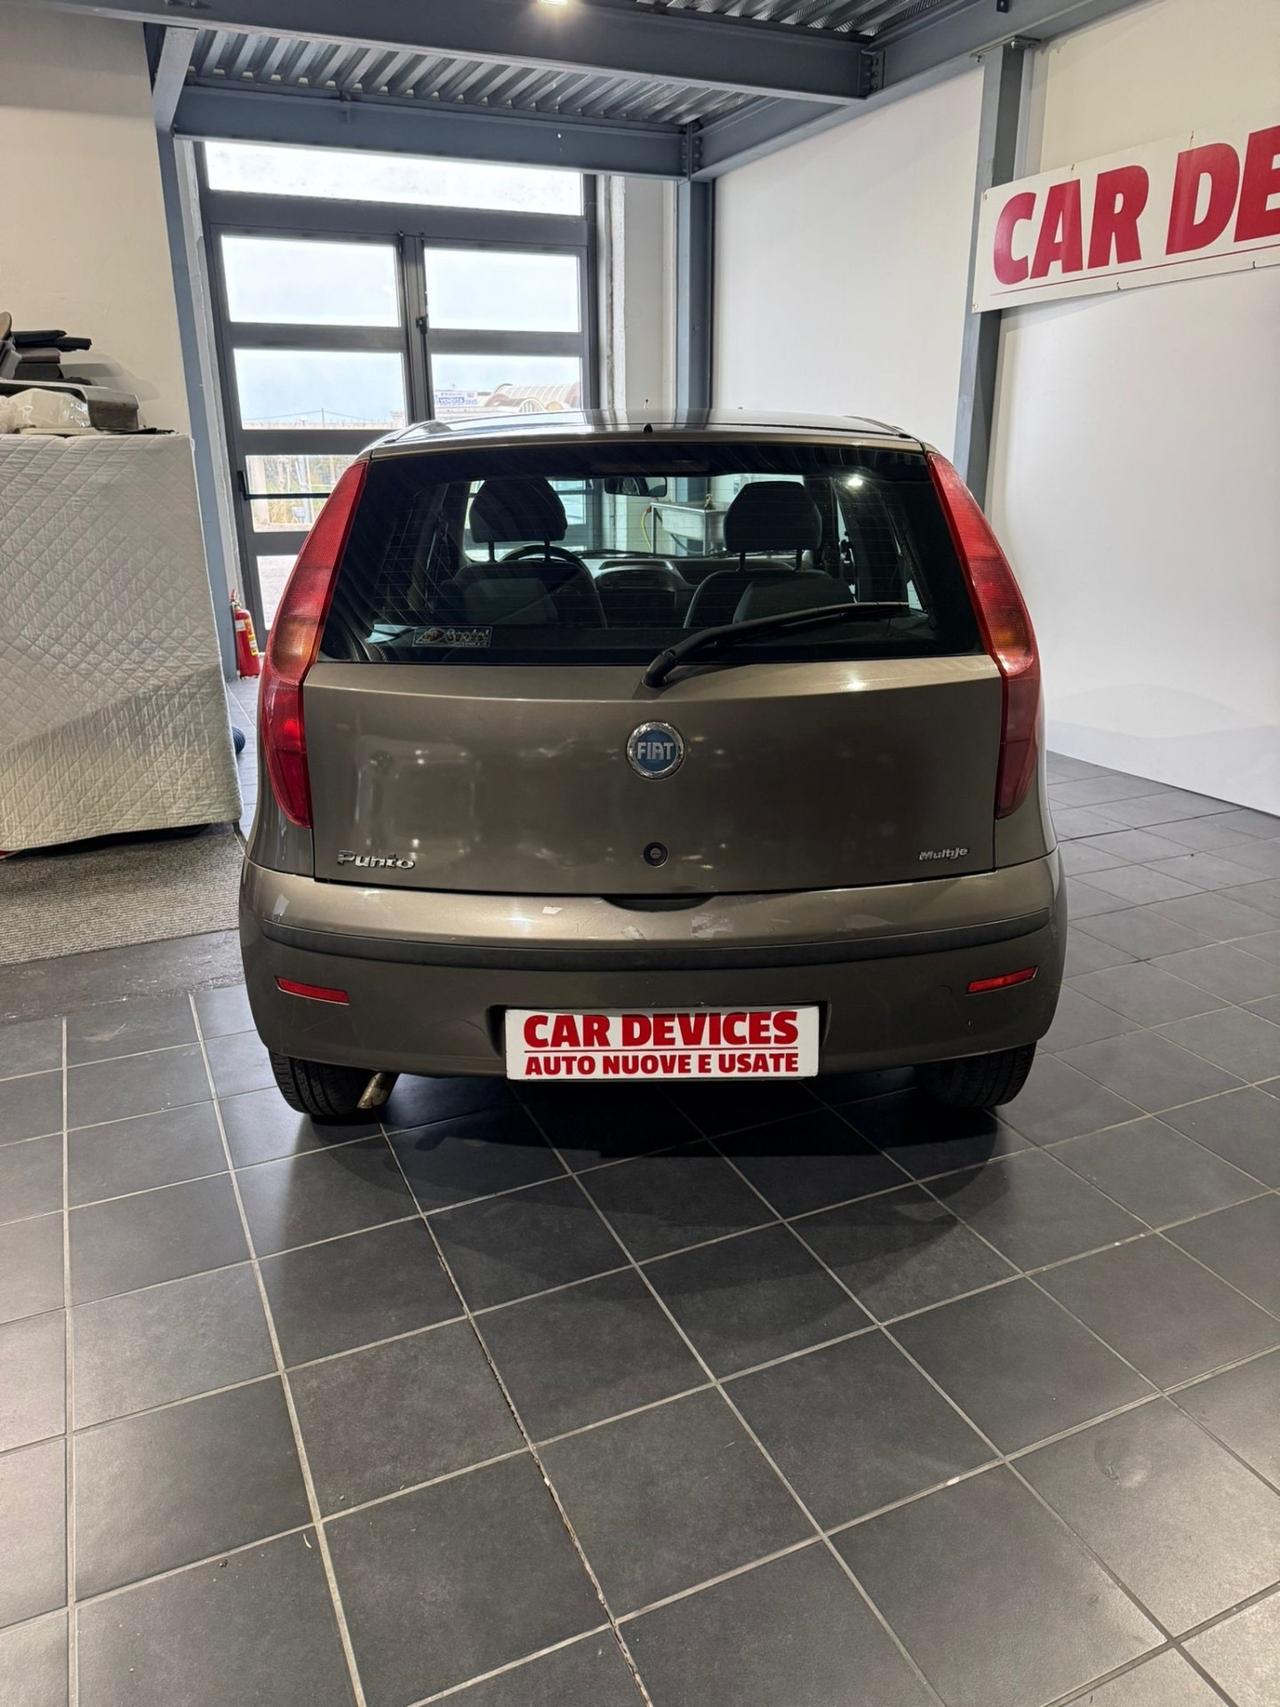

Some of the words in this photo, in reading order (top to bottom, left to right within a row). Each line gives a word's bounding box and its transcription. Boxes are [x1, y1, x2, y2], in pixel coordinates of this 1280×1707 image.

[993, 165, 1149, 285] CAR
[637, 742, 674, 760] FIAT
[337, 849, 415, 869] Punto
[523, 1014, 610, 1048] CAR
[622, 1011, 799, 1048] DEVICES
[525, 1054, 596, 1075] AUTO
[602, 1053, 691, 1074] NUOVE
[698, 1053, 711, 1073] E
[718, 1052, 799, 1073] USATE
